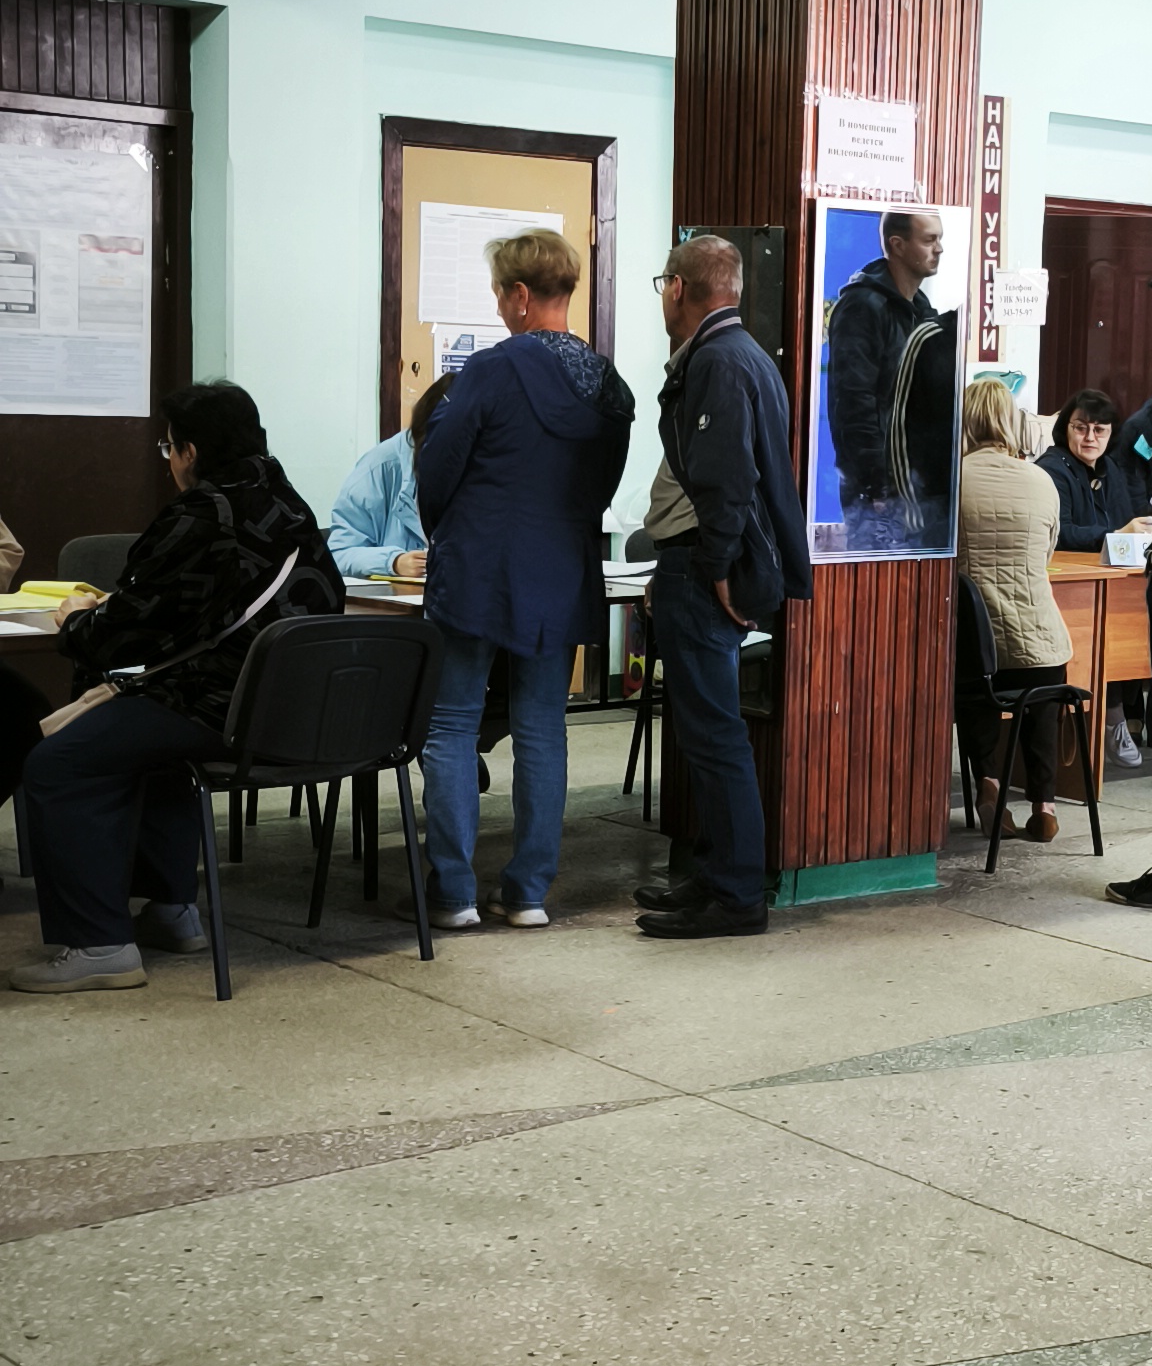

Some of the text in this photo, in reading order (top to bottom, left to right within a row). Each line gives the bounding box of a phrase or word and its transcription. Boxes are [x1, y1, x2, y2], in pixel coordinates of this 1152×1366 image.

[839, 118, 846, 128] В
[851, 136, 884, 147] ведется
[984, 101, 1001, 195] НАШИ
[827, 147, 905, 163] видеонаблюдение
[982, 212, 999, 351] УСПЕХИ
